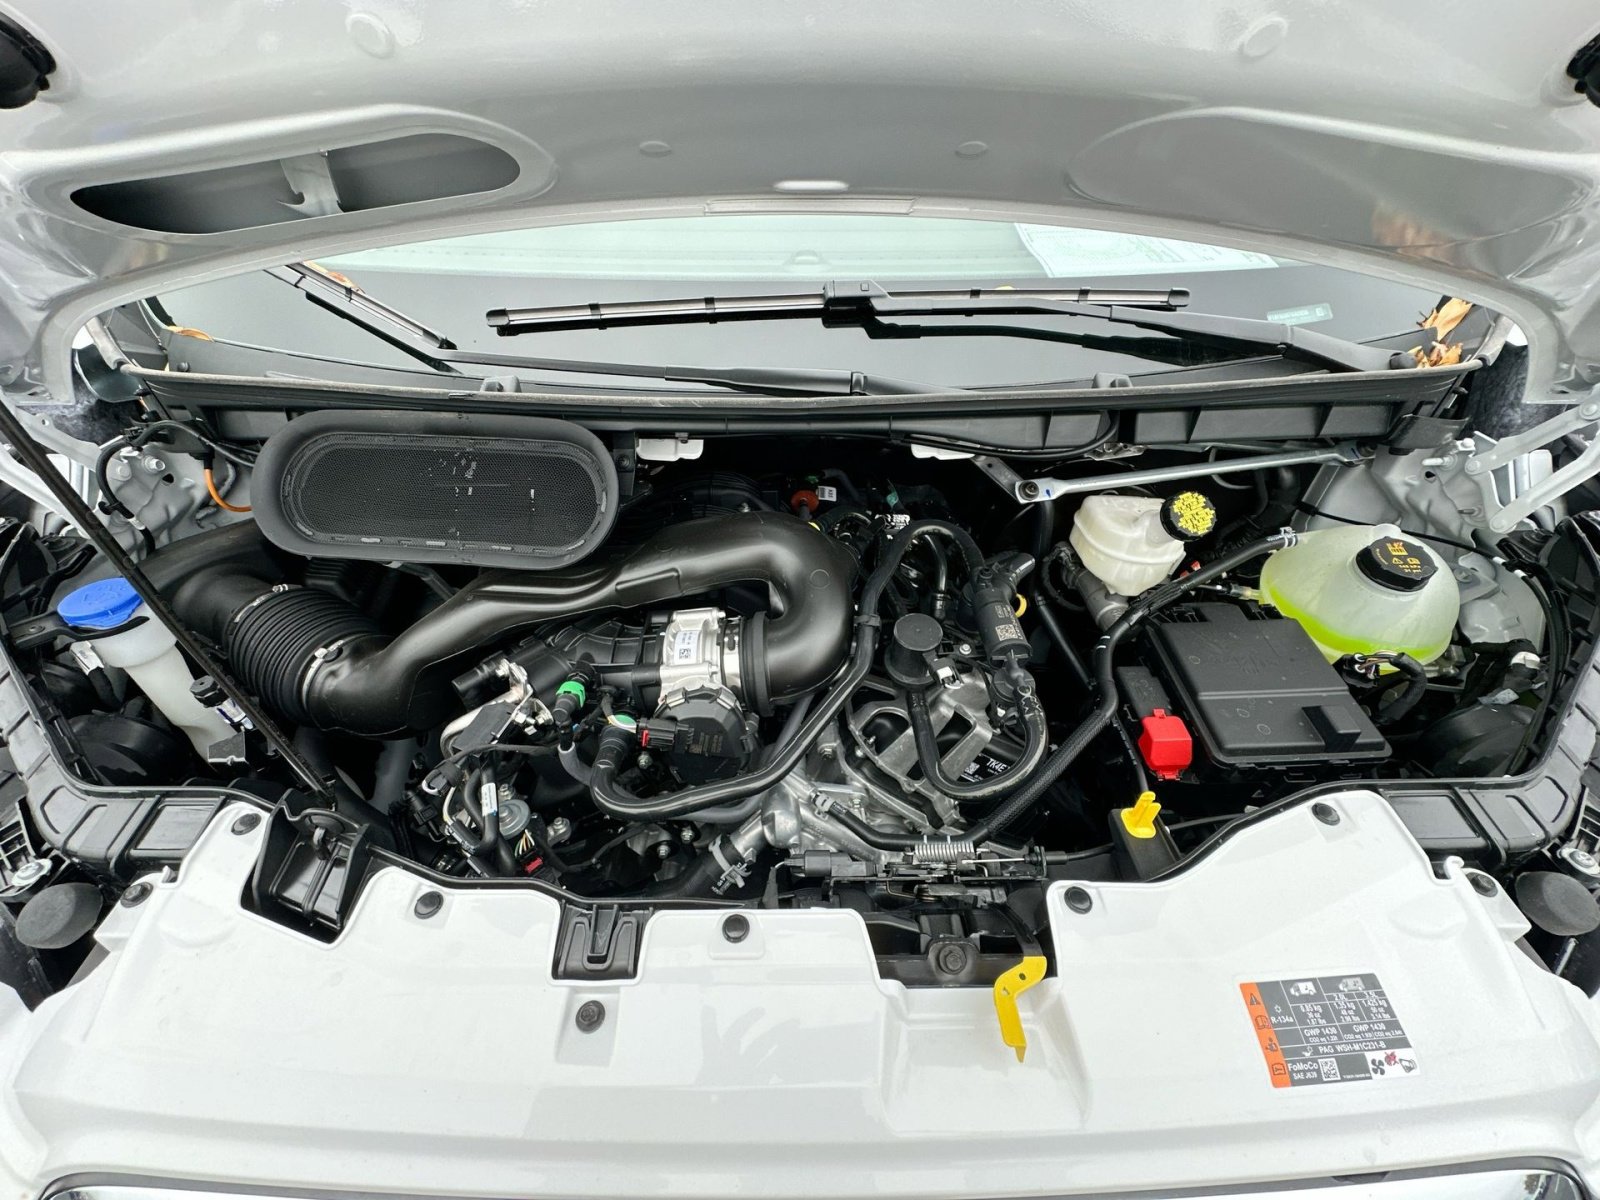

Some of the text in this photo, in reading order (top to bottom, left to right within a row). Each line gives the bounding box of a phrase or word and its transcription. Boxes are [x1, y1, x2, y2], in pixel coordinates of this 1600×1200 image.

[1271, 1015, 1294, 1024] R-134a
[1304, 1027, 1338, 1036] GWP 1430
[1353, 1022, 1386, 1032] GWP 1430
[1318, 1045, 1334, 1054] PAG
[1287, 1061, 1319, 1071] FoMoCo
[1292, 1072, 1305, 1080] SAE
